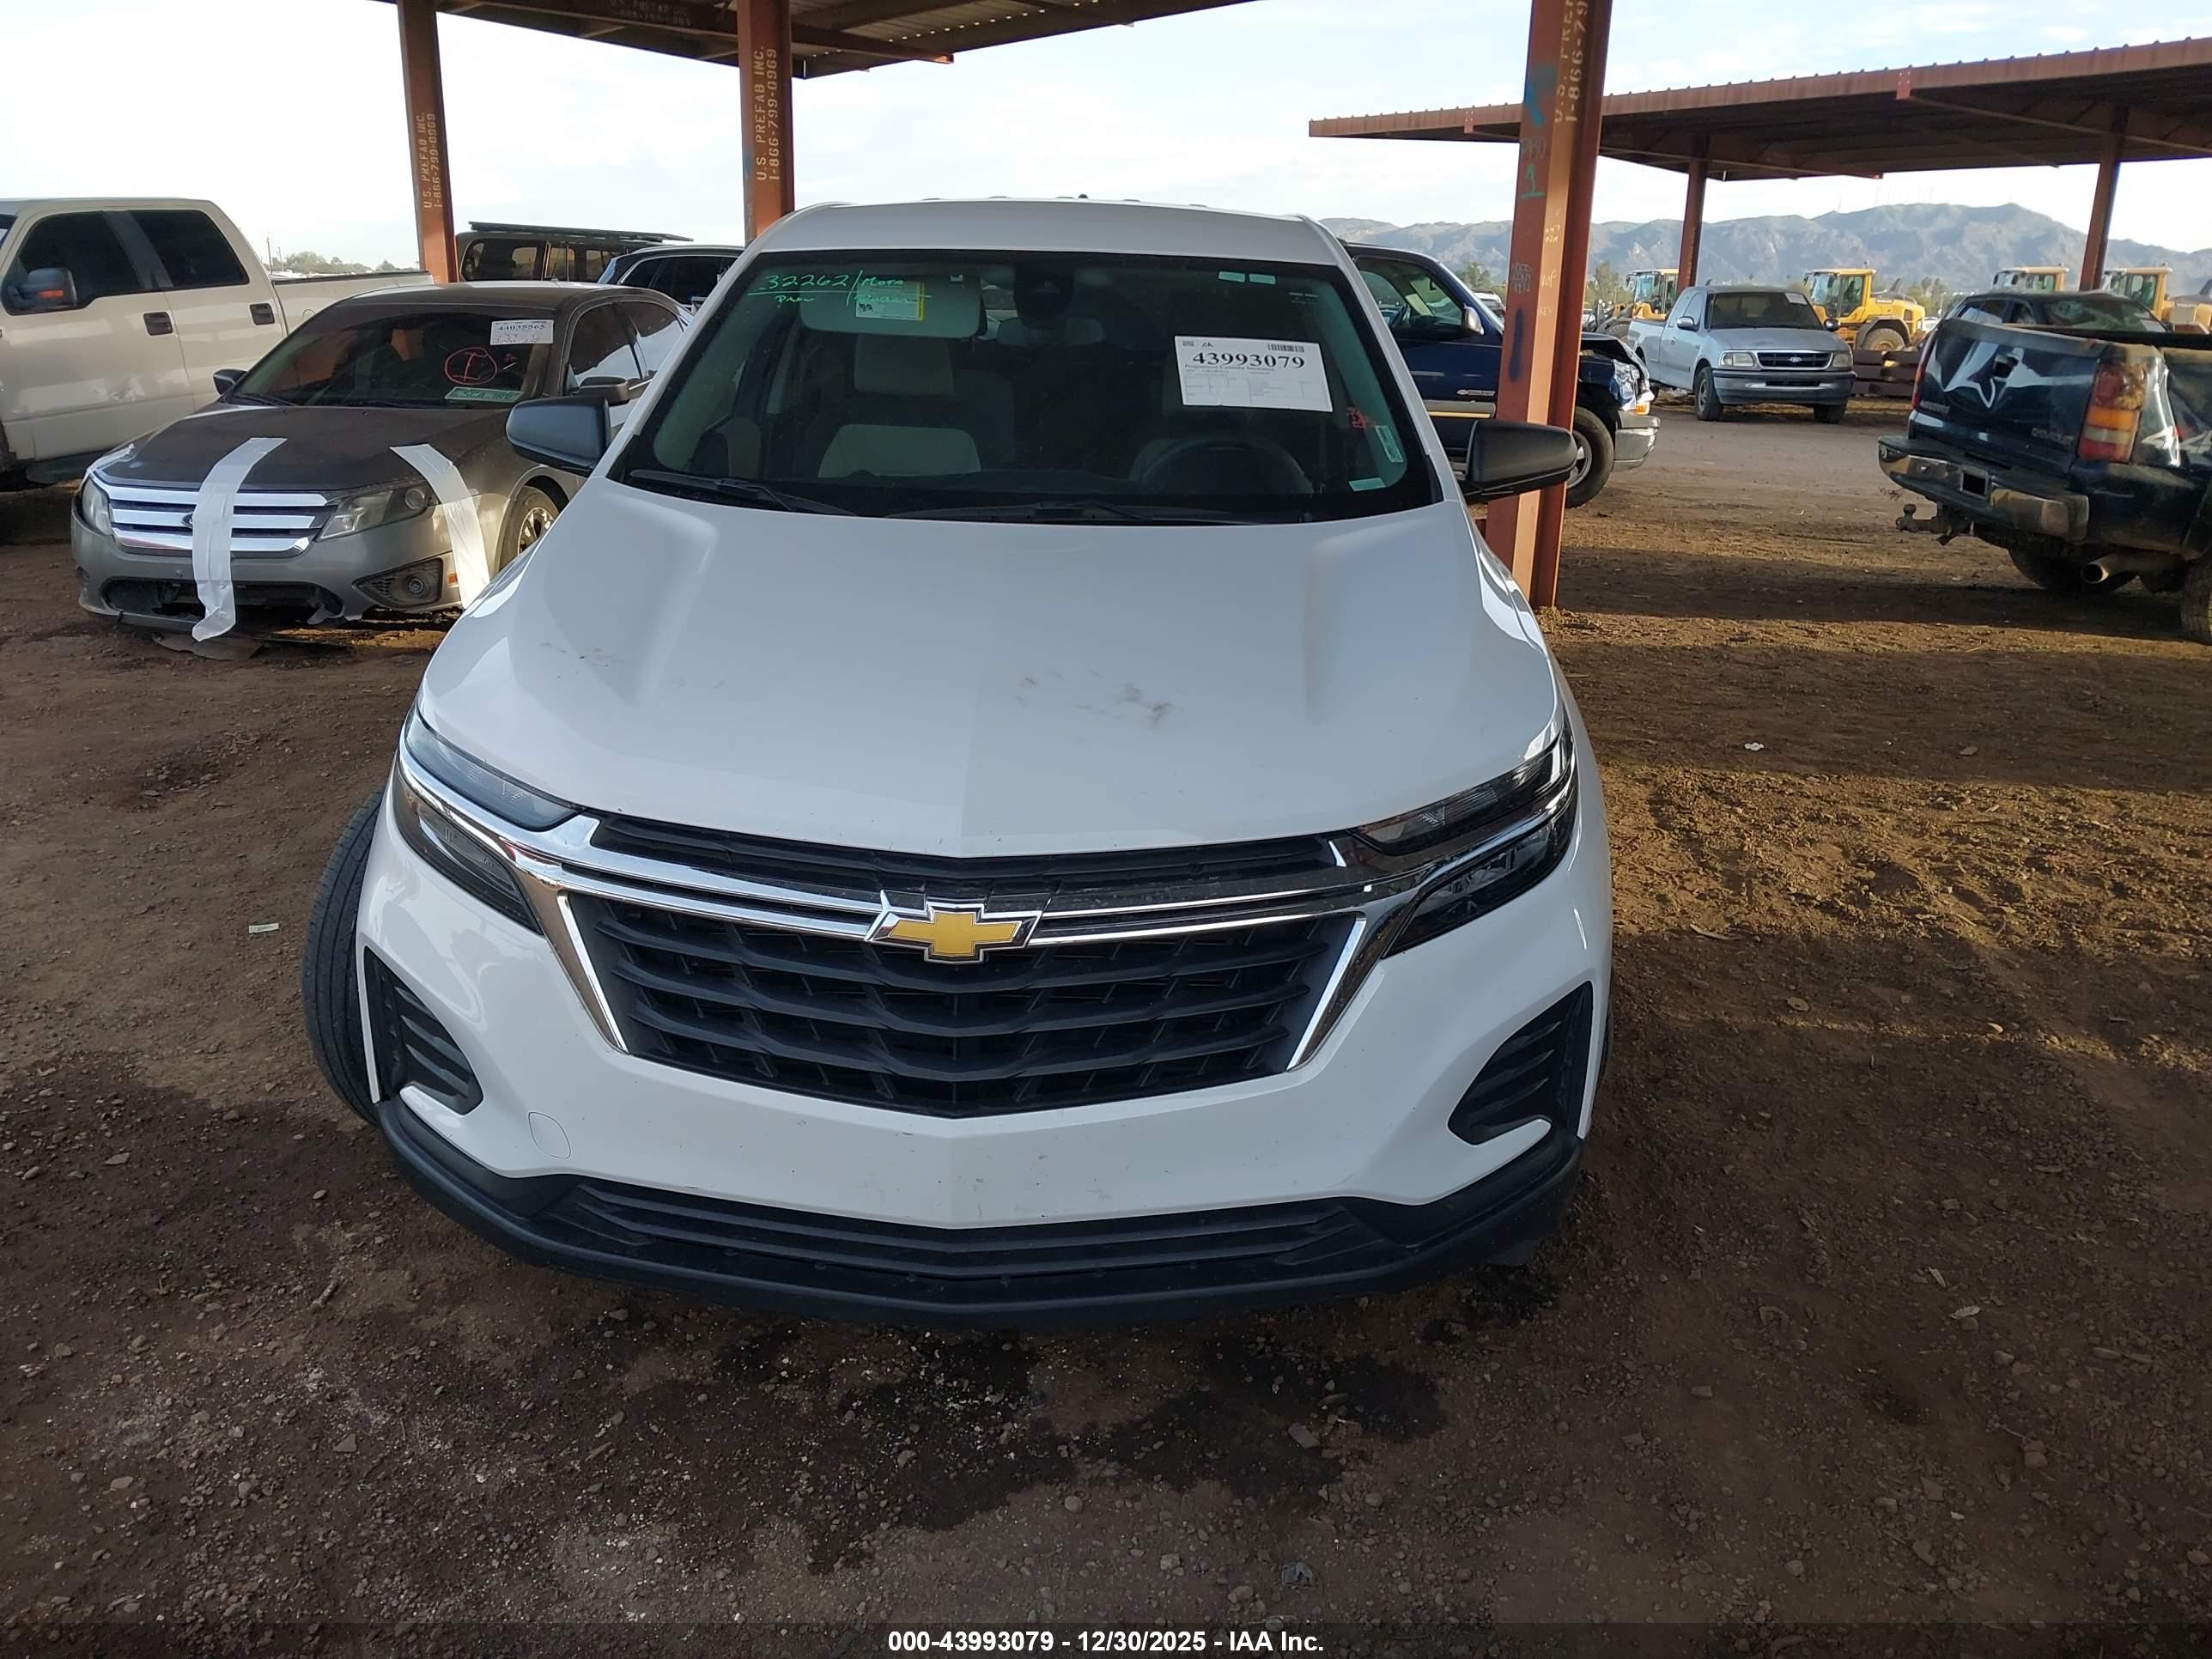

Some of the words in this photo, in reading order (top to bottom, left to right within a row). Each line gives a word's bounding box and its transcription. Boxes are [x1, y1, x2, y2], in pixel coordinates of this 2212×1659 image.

[753, 46, 765, 76] INC.
[416, 112, 427, 134] INC.
[754, 84, 766, 143] PREFAB
[766, 48, 780, 180] 1-866-799-0969
[418, 138, 430, 182] PREFAB
[426, 113, 442, 208] 1-866-799-0969
[756, 152, 767, 181] U.S.
[422, 187, 433, 209] U.S.
[1192, 351, 1305, 369] 43993079
